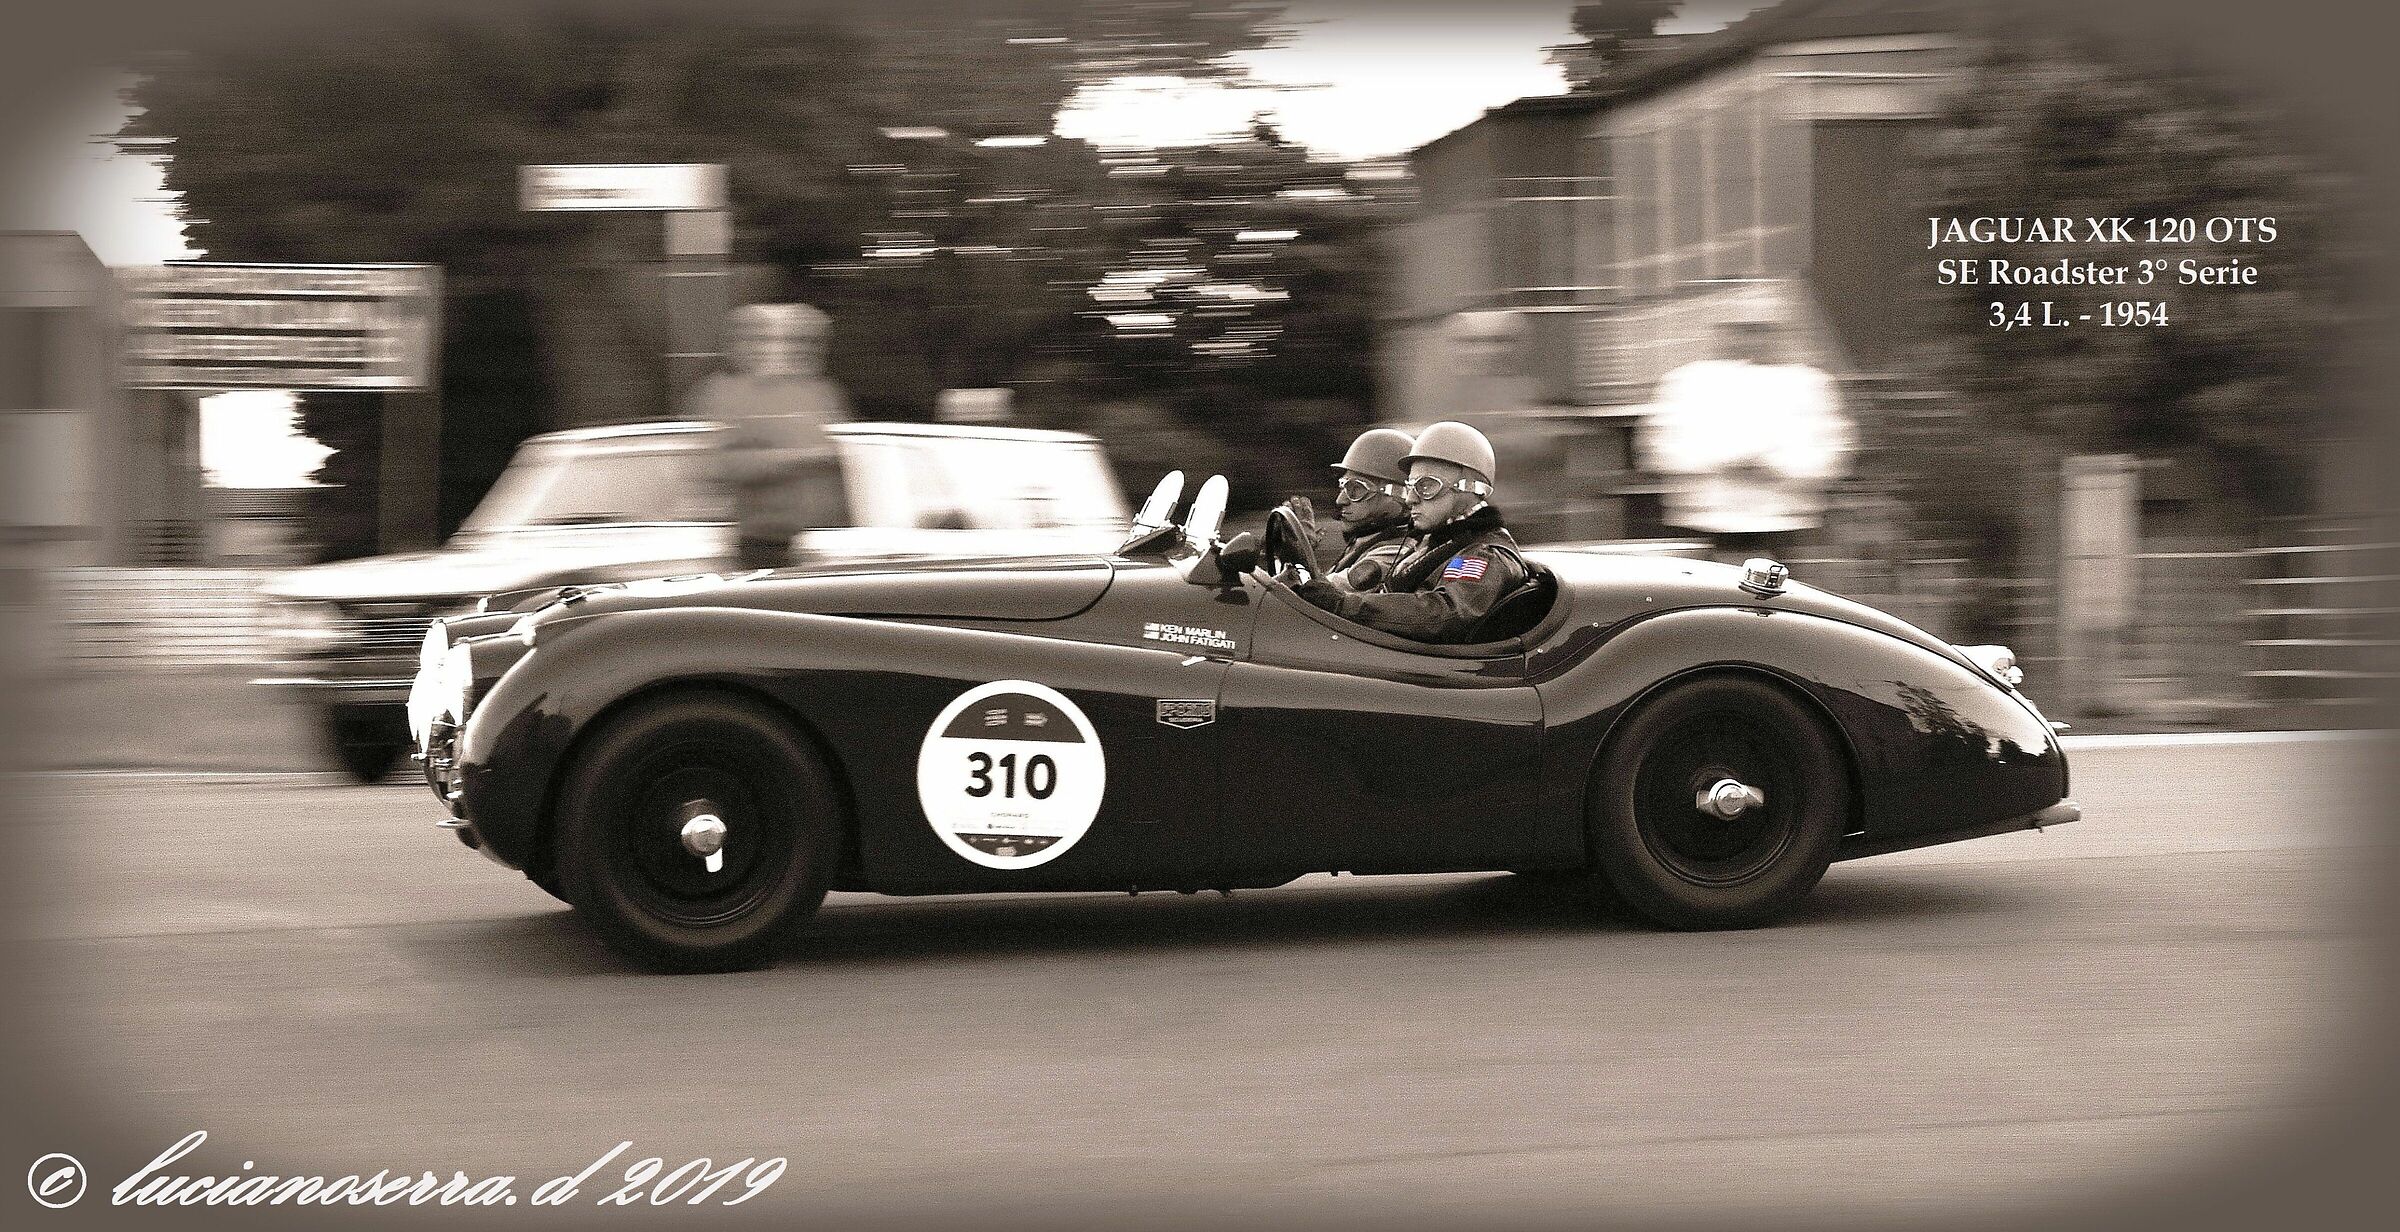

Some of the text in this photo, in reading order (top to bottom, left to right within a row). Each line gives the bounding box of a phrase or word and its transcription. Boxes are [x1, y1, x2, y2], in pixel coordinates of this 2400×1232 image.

[1160, 623, 1226, 640] KEN MARLIN
[1159, 632, 1236, 649] JOHN FATIGATI
[965, 751, 1057, 800] 310
